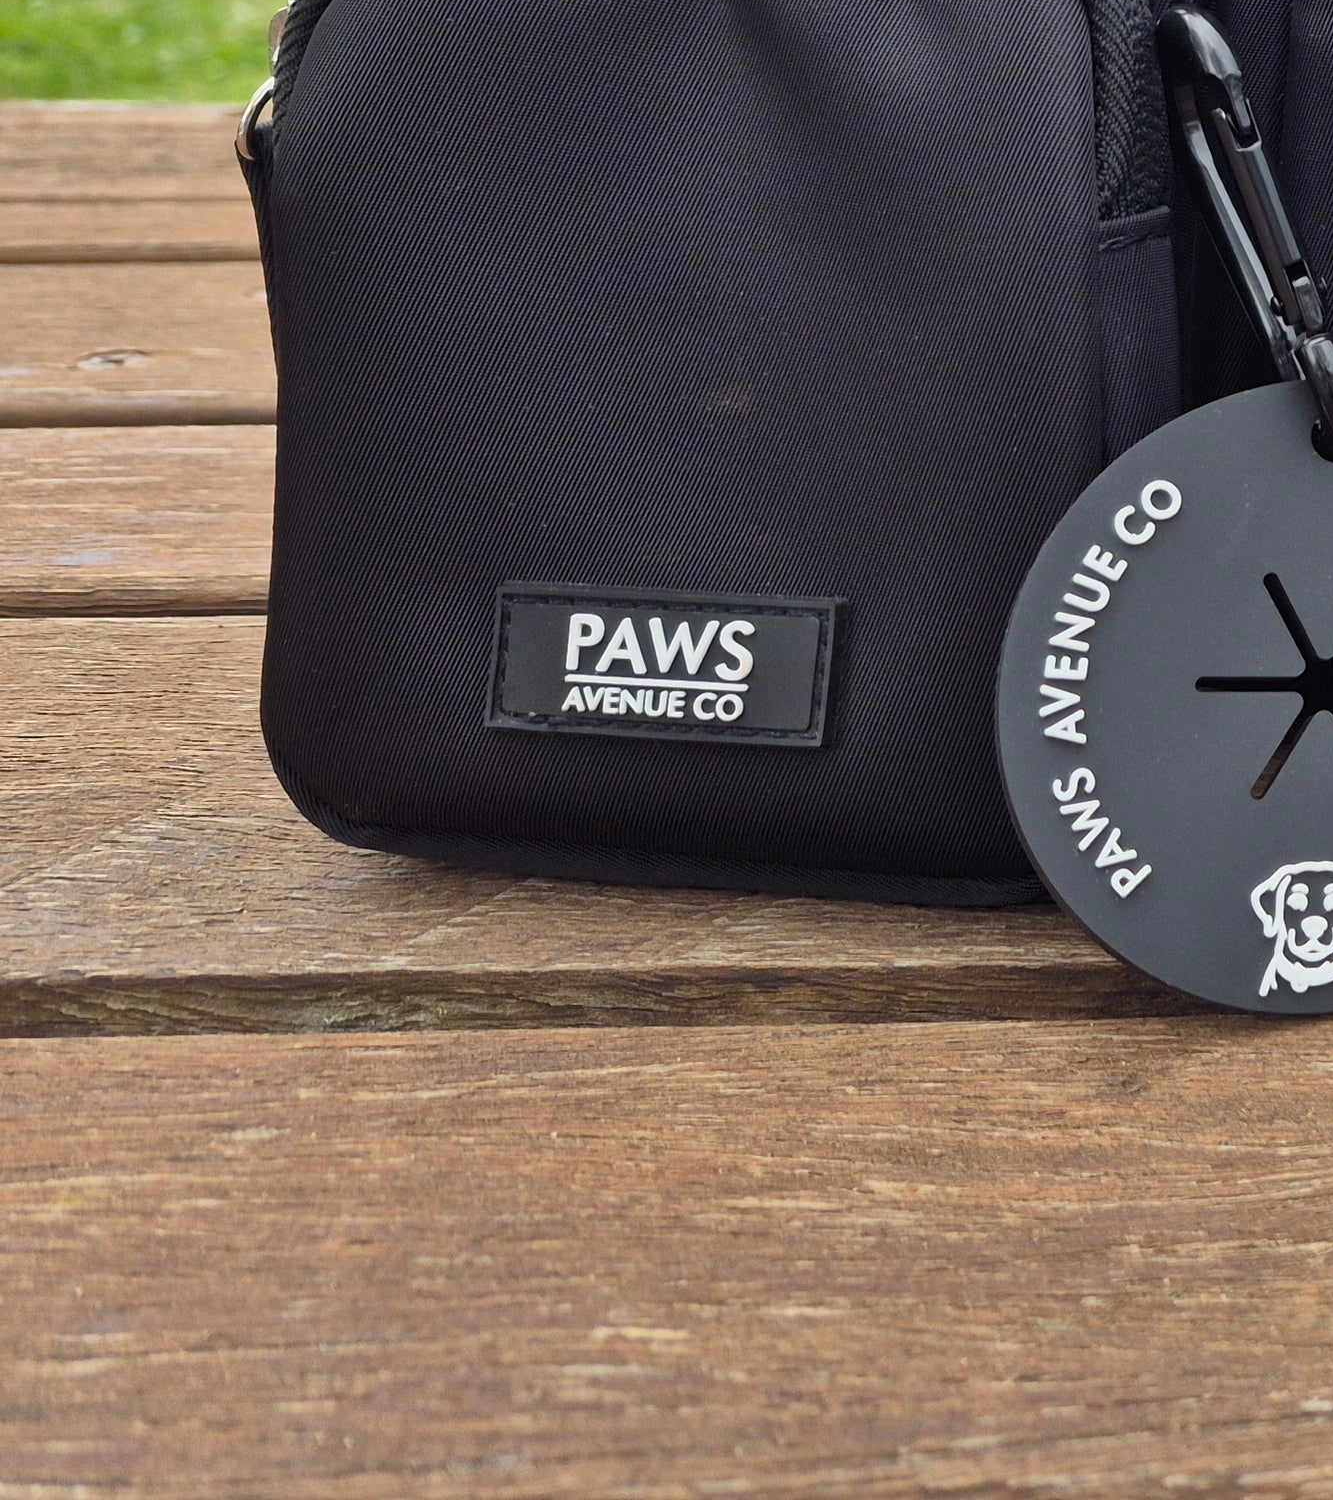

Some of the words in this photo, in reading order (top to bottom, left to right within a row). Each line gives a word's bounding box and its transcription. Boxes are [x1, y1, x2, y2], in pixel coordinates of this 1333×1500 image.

[1114, 479, 1183, 546] CO
[565, 613, 756, 681] PAWS
[1038, 544, 1128, 744] AVENUE
[561, 685, 686, 718] AVENUE
[692, 692, 744, 722] CO
[1052, 767, 1152, 898] PAWS
